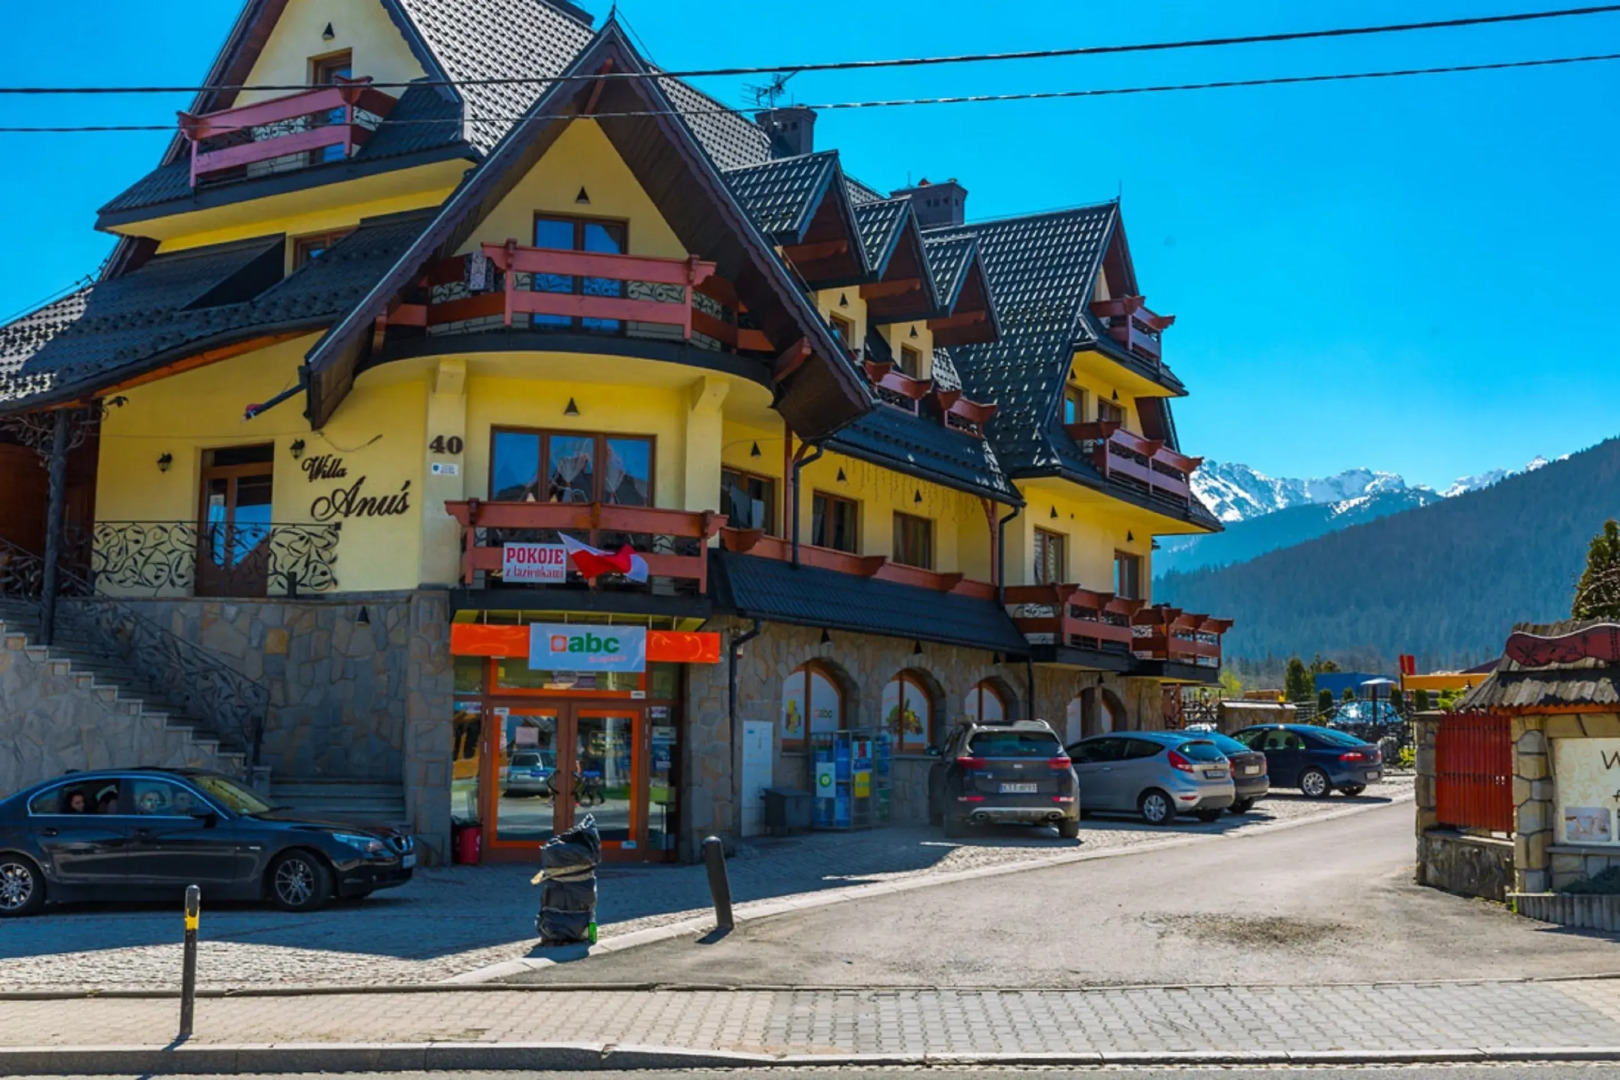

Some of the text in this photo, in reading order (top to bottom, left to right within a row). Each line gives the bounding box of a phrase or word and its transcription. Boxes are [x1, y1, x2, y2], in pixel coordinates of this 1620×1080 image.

[429, 435, 464, 455] 40
[301, 453, 347, 483] Willa
[310, 475, 412, 522] Anuś
[506, 547, 564, 564] POKOJE
[568, 632, 620, 653] abc
